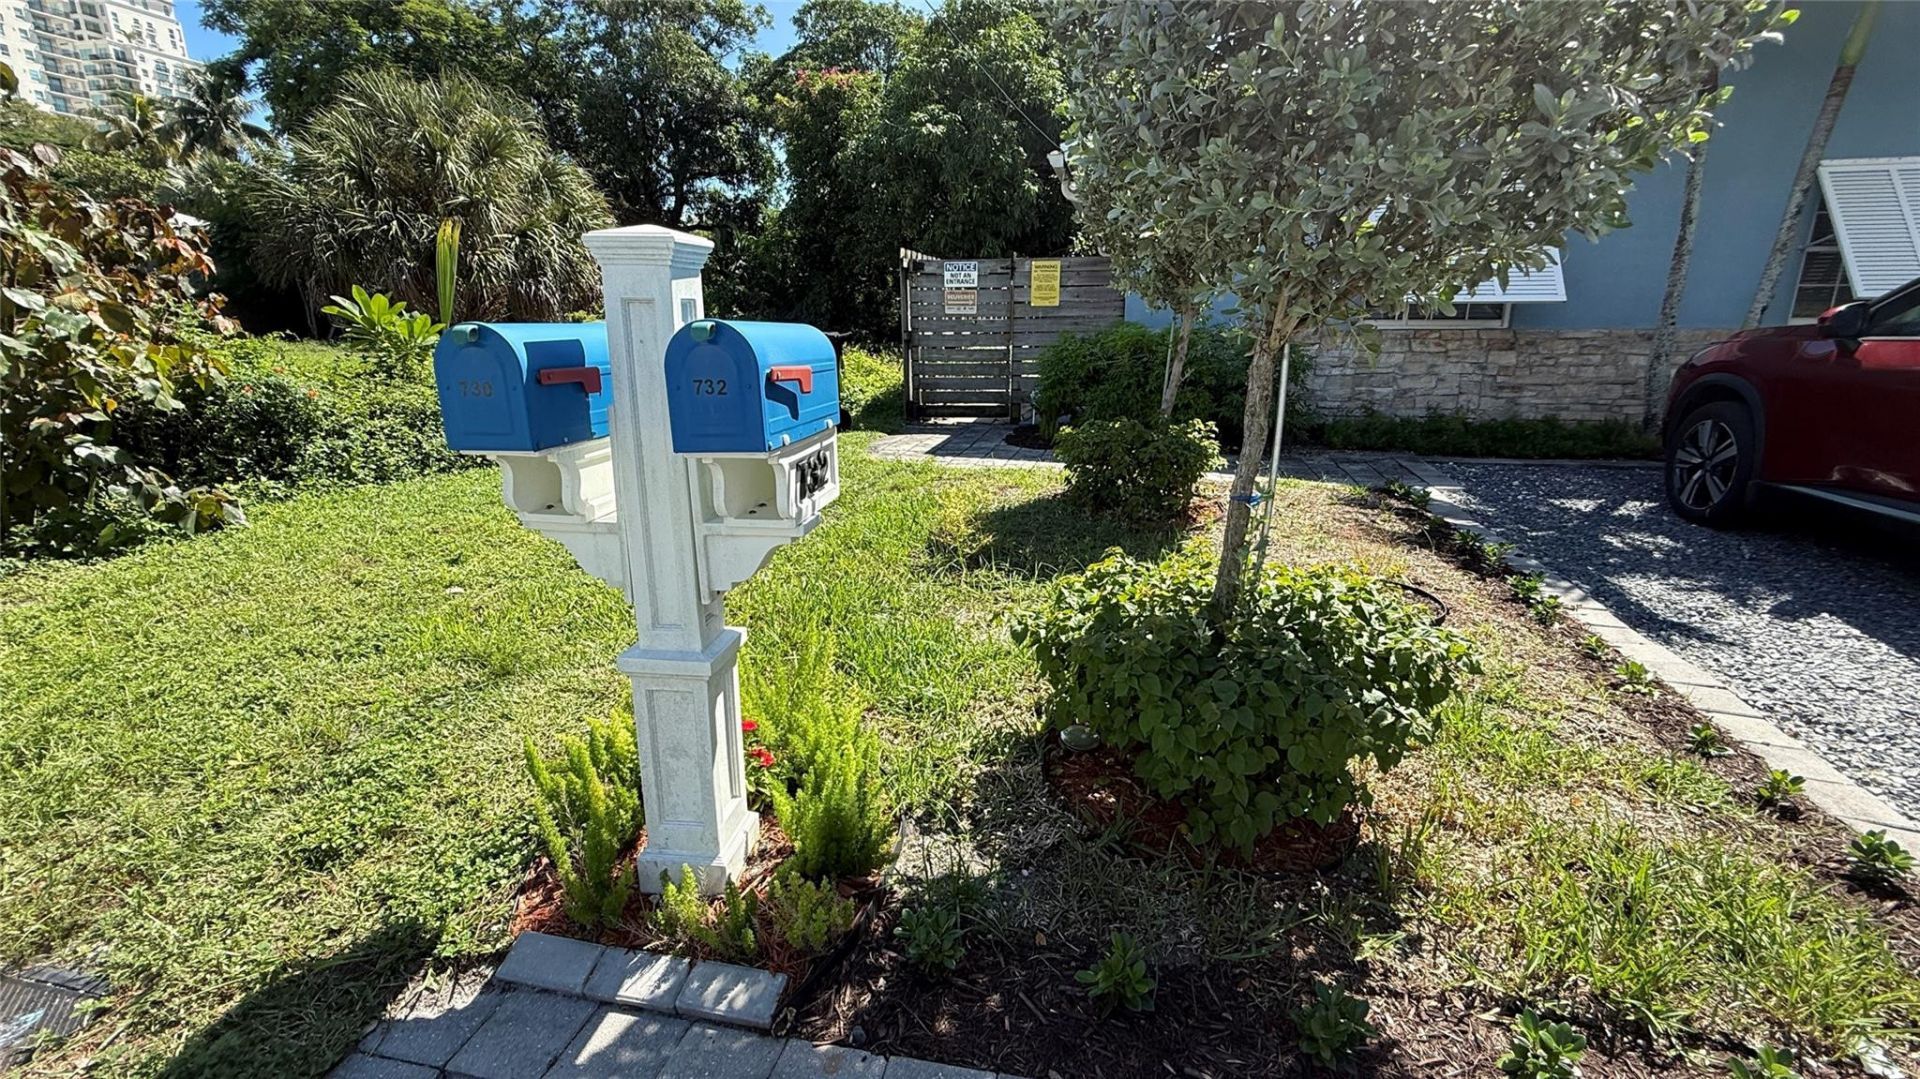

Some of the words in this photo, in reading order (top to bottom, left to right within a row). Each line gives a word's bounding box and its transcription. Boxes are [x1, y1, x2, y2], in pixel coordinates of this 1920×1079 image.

[946, 263, 976, 271] NOTICE
[458, 380, 493, 398] 730
[692, 379, 728, 396] 732
